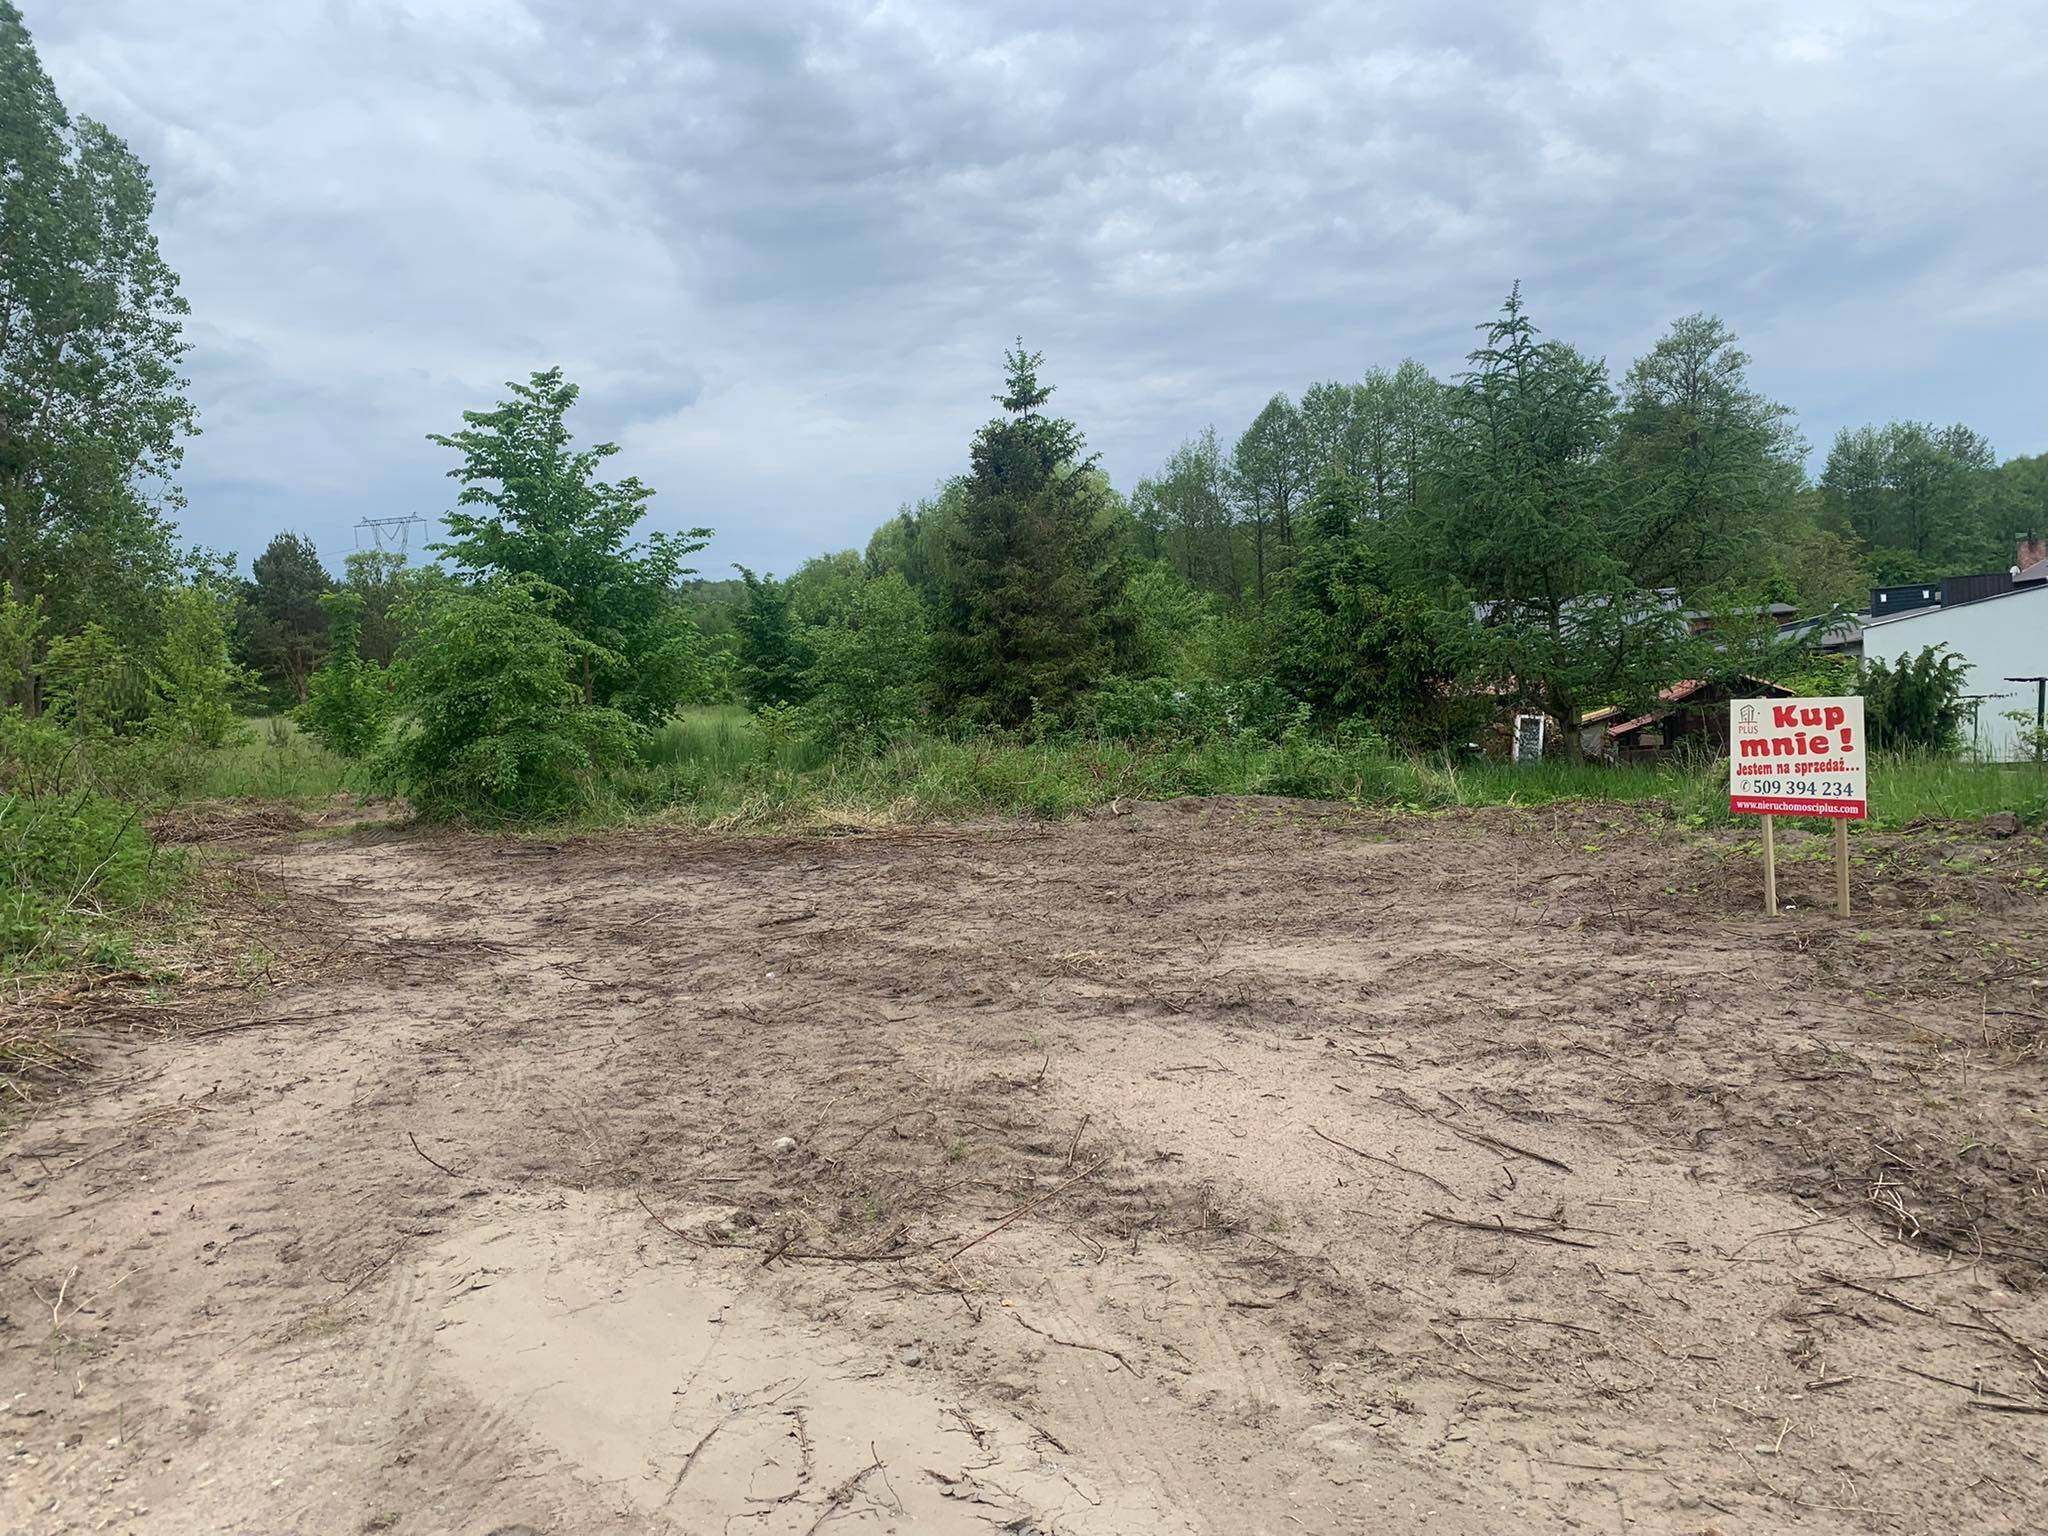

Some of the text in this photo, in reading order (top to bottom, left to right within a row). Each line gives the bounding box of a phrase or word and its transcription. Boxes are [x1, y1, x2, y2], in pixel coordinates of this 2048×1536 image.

[1773, 705, 1844, 730] Kup
[1739, 725, 1758, 734] PLUS
[1737, 763, 1772, 775] Jestem
[1777, 763, 1790, 774] na
[1754, 780, 1853, 796] 509 394 234
[1736, 800, 1858, 814] www.nieruchomosciplus.com
